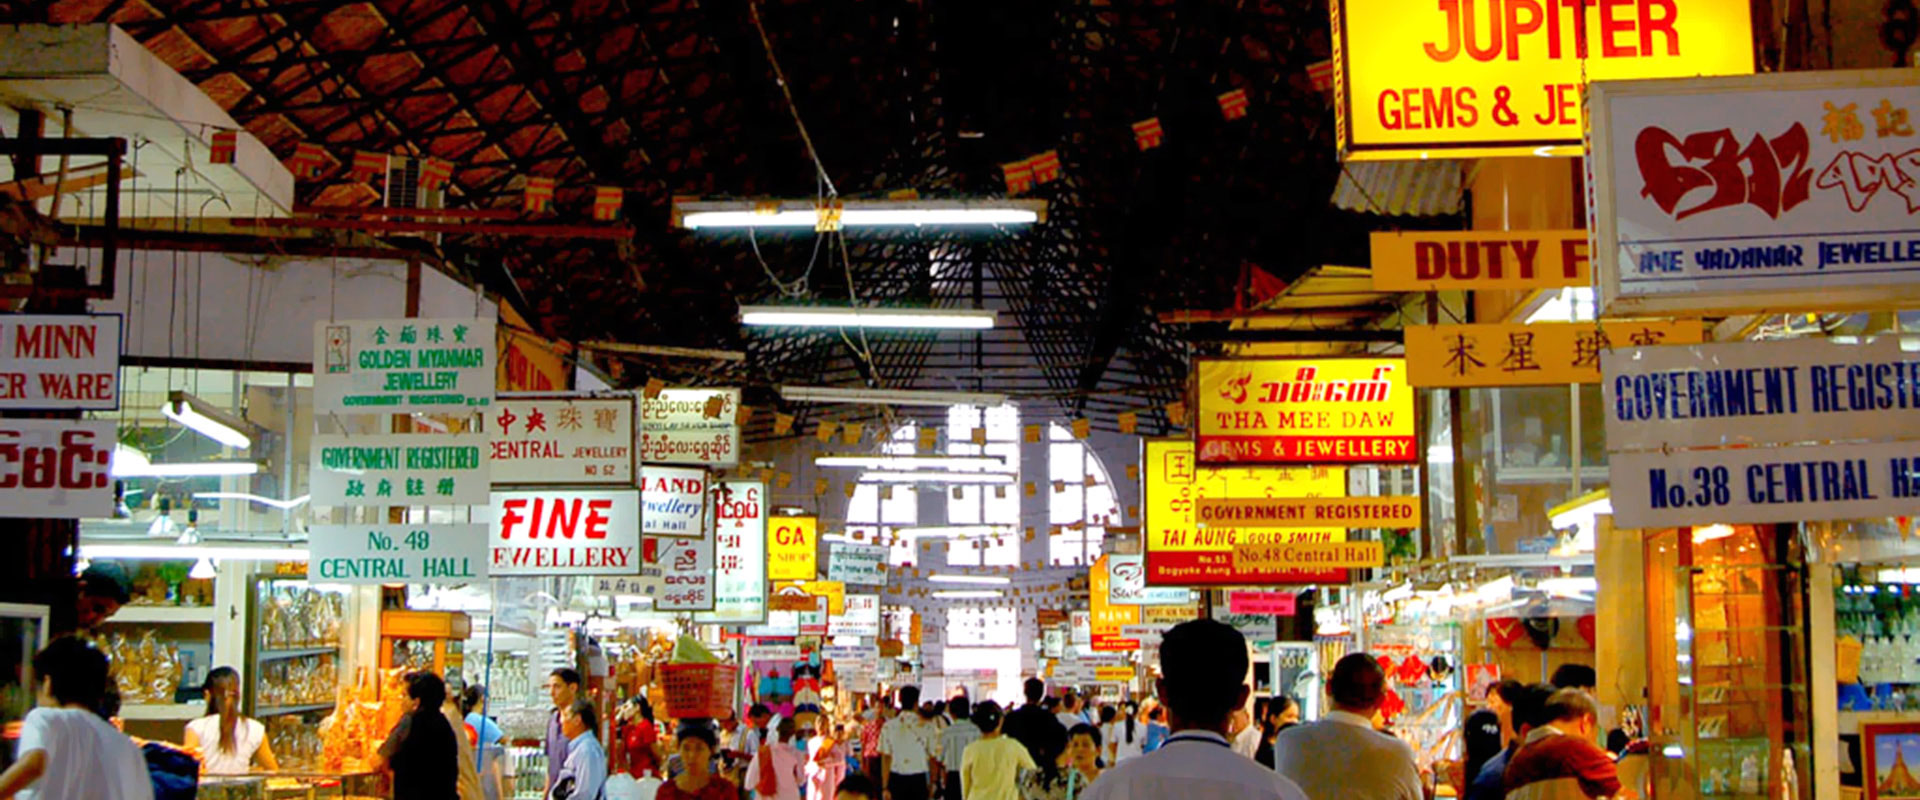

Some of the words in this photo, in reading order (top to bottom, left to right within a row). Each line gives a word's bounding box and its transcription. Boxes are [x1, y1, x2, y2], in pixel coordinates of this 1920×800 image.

[1423, 0, 1680, 62] JUPITER
[1378, 87, 1479, 130] GEMS
[1492, 86, 1520, 127] &
[1534, 83, 1588, 125] JE
[1414, 240, 1540, 280] DUTY
[1695, 244, 1804, 270] YADANAR
[15, 325, 97, 359] MINN
[359, 349, 412, 369] GOLDEN
[418, 347, 484, 368] MYANMAR
[39, 373, 114, 400] WARE
[383, 371, 459, 391] JEWELLERY
[1615, 366, 1800, 421] GOVERNMENT
[1216, 412, 1268, 429] THA
[1278, 411, 1331, 429] MEE
[1342, 411, 1395, 429] DAW
[321, 446, 400, 470] GOVERNMENT
[406, 445, 480, 470] REGISTERED
[572, 446, 628, 459] JEWELLERY
[1205, 439, 1262, 457] GEMS
[1273, 439, 1286, 457] &
[1296, 439, 1411, 457] JEWELLERY
[1747, 459, 1879, 504] CENTRAL
[500, 497, 613, 540] FINE
[1201, 505, 1306, 520] GOVERNMENT
[1315, 504, 1413, 519] REGISTERED
[662, 521, 687, 531] Hall
[1163, 529, 1187, 546] TAI
[1194, 529, 1237, 546] AUNG
[1248, 532, 1282, 544] GOLD
[1288, 531, 1332, 544] SMITH
[1284, 547, 1339, 563] Central
[1345, 546, 1377, 562] Hall
[320, 558, 411, 578] CENTRAL
[423, 557, 476, 578] HALL
[1206, 566, 1231, 577] Aung
